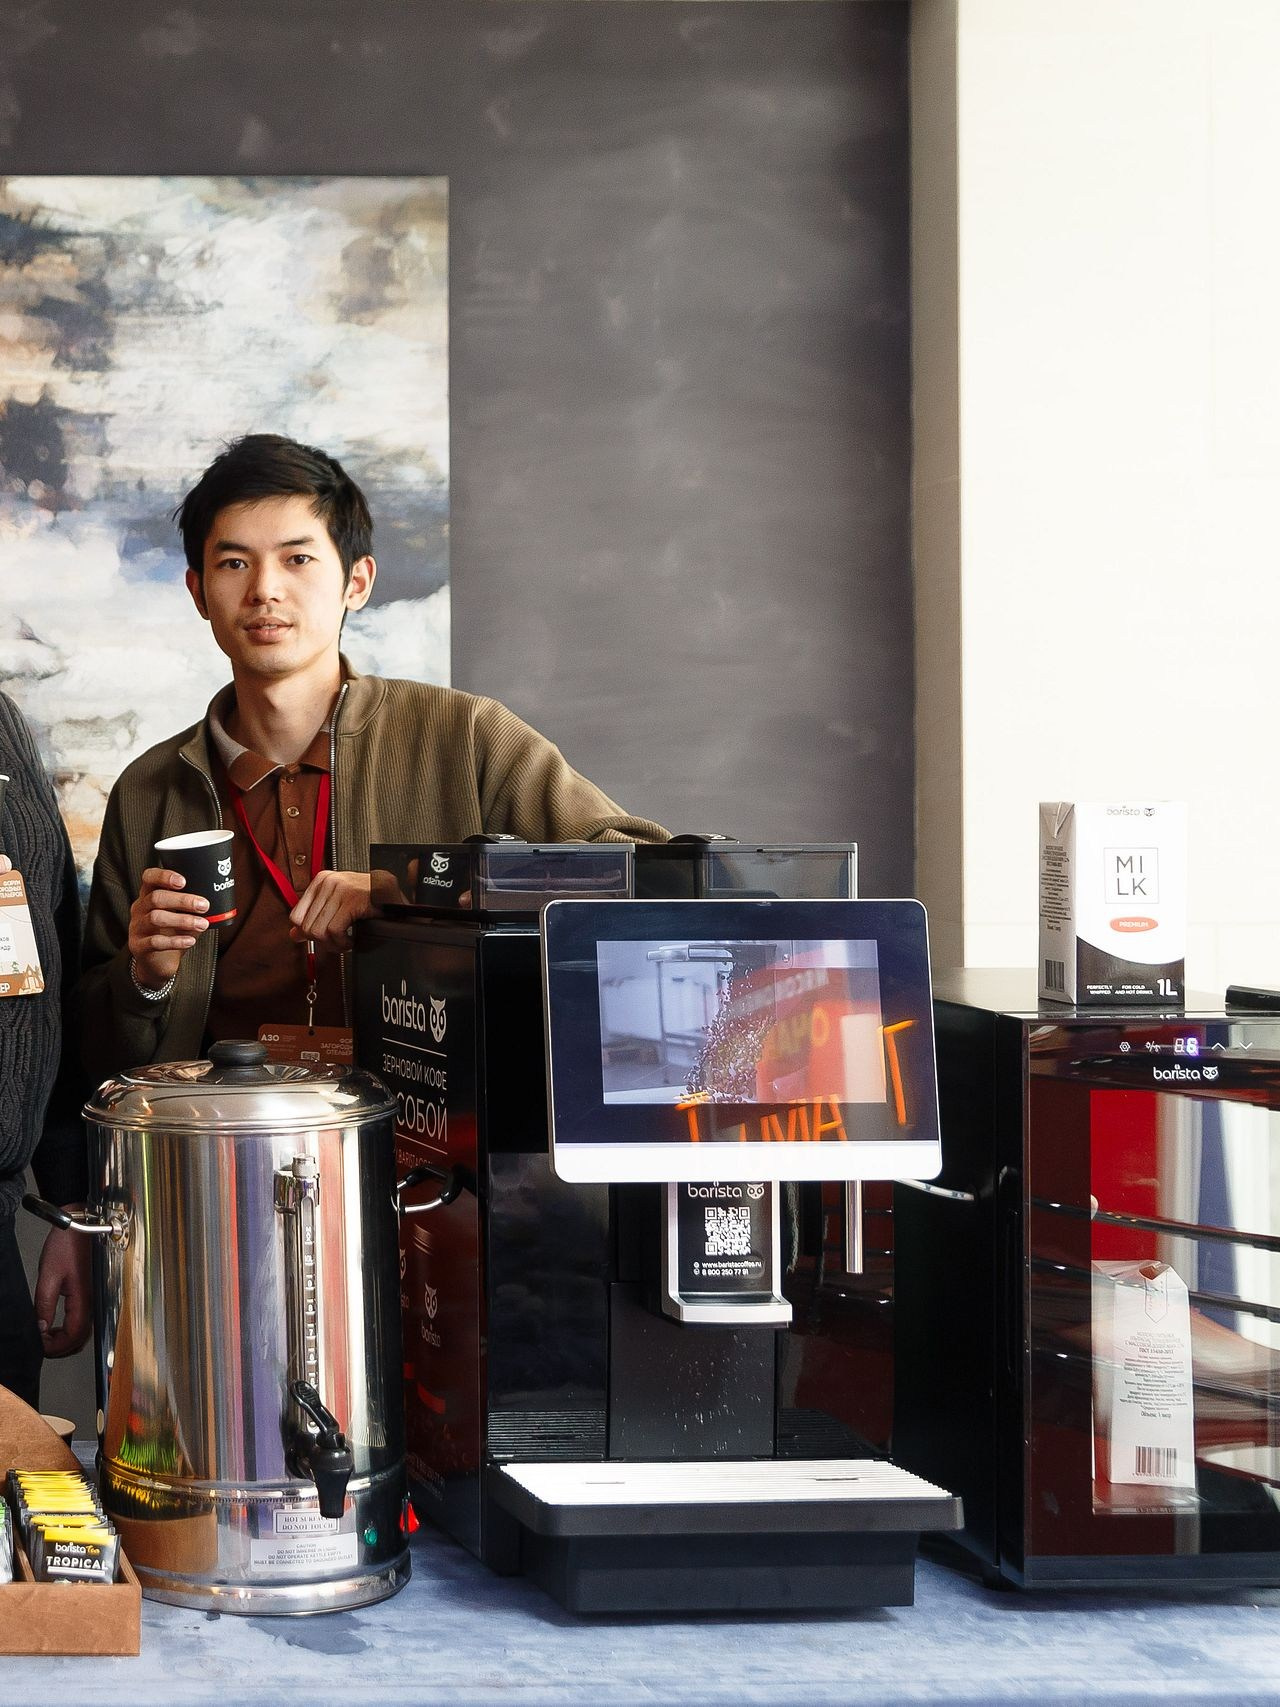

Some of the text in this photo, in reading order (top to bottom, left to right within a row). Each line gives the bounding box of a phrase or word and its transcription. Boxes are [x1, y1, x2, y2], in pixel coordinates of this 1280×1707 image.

[1107, 805, 1140, 816] barista
[1157, 979, 1178, 996] 1L
[382, 980, 426, 1032] barista
[382, 1053, 447, 1090] ЗЕРНОВОЙ КОФЕ
[1153, 1064, 1201, 1080] barista
[688, 1181, 742, 1198] barista
[55, 1541, 86, 1554] barista
[46, 1555, 109, 1570] TROPICAL
